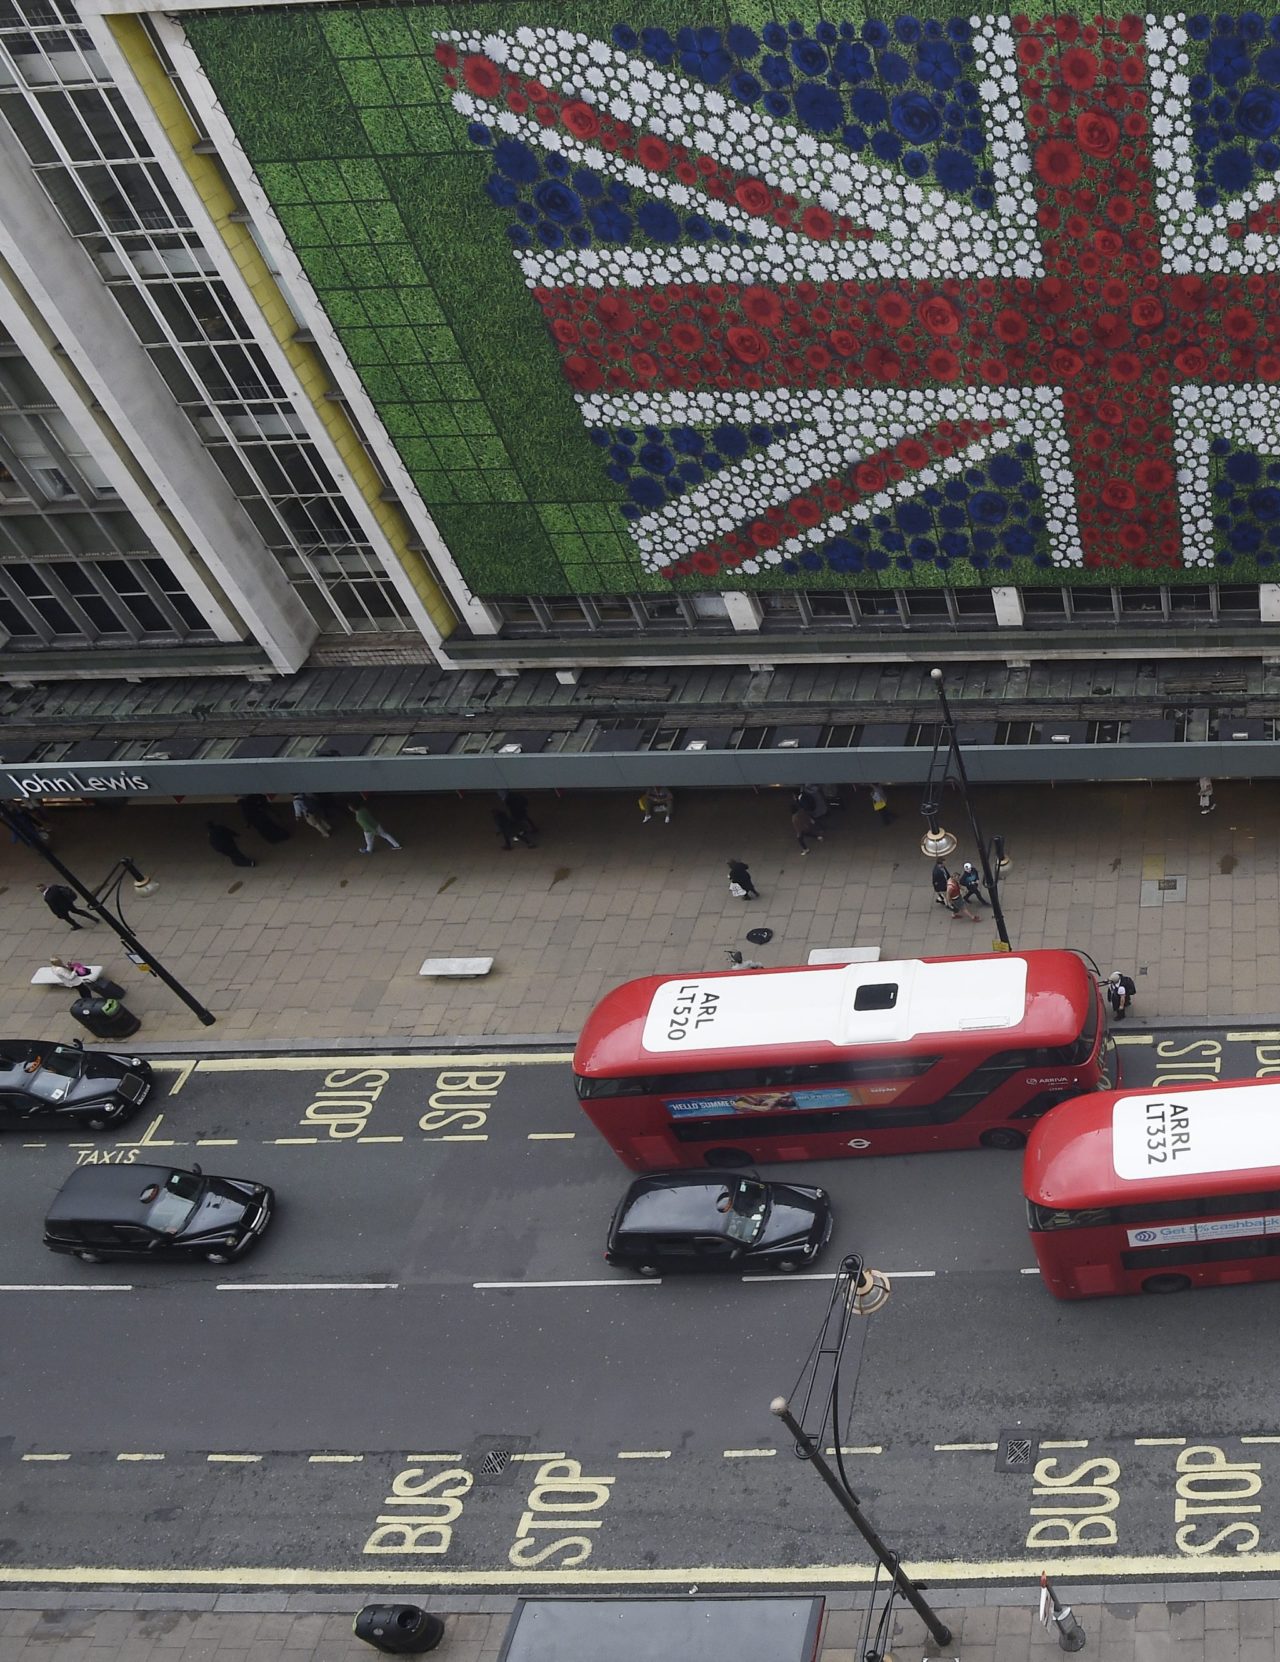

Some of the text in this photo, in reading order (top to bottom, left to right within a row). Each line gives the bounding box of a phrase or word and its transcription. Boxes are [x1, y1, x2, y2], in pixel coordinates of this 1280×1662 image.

[6, 770, 149, 798] John Lewis
[667, 985, 699, 1041] LT520
[697, 993, 720, 1029] ARL
[299, 1069, 390, 1139] STOP
[419, 1071, 506, 1131] BUS
[672, 1101, 736, 1111] HELLO SUMMER
[75, 1149, 141, 1165] TAXIS
[1146, 1103, 1167, 1165] LT332
[1169, 1104, 1191, 1160] ARRL
[1160, 1226, 1186, 1236] Get
[1211, 1217, 1279, 1231] cashback
[362, 1468, 473, 1554] BUS
[508, 1459, 616, 1567] STOP
[1026, 1457, 1120, 1548] BUS
[1175, 1446, 1263, 1554] STOP
